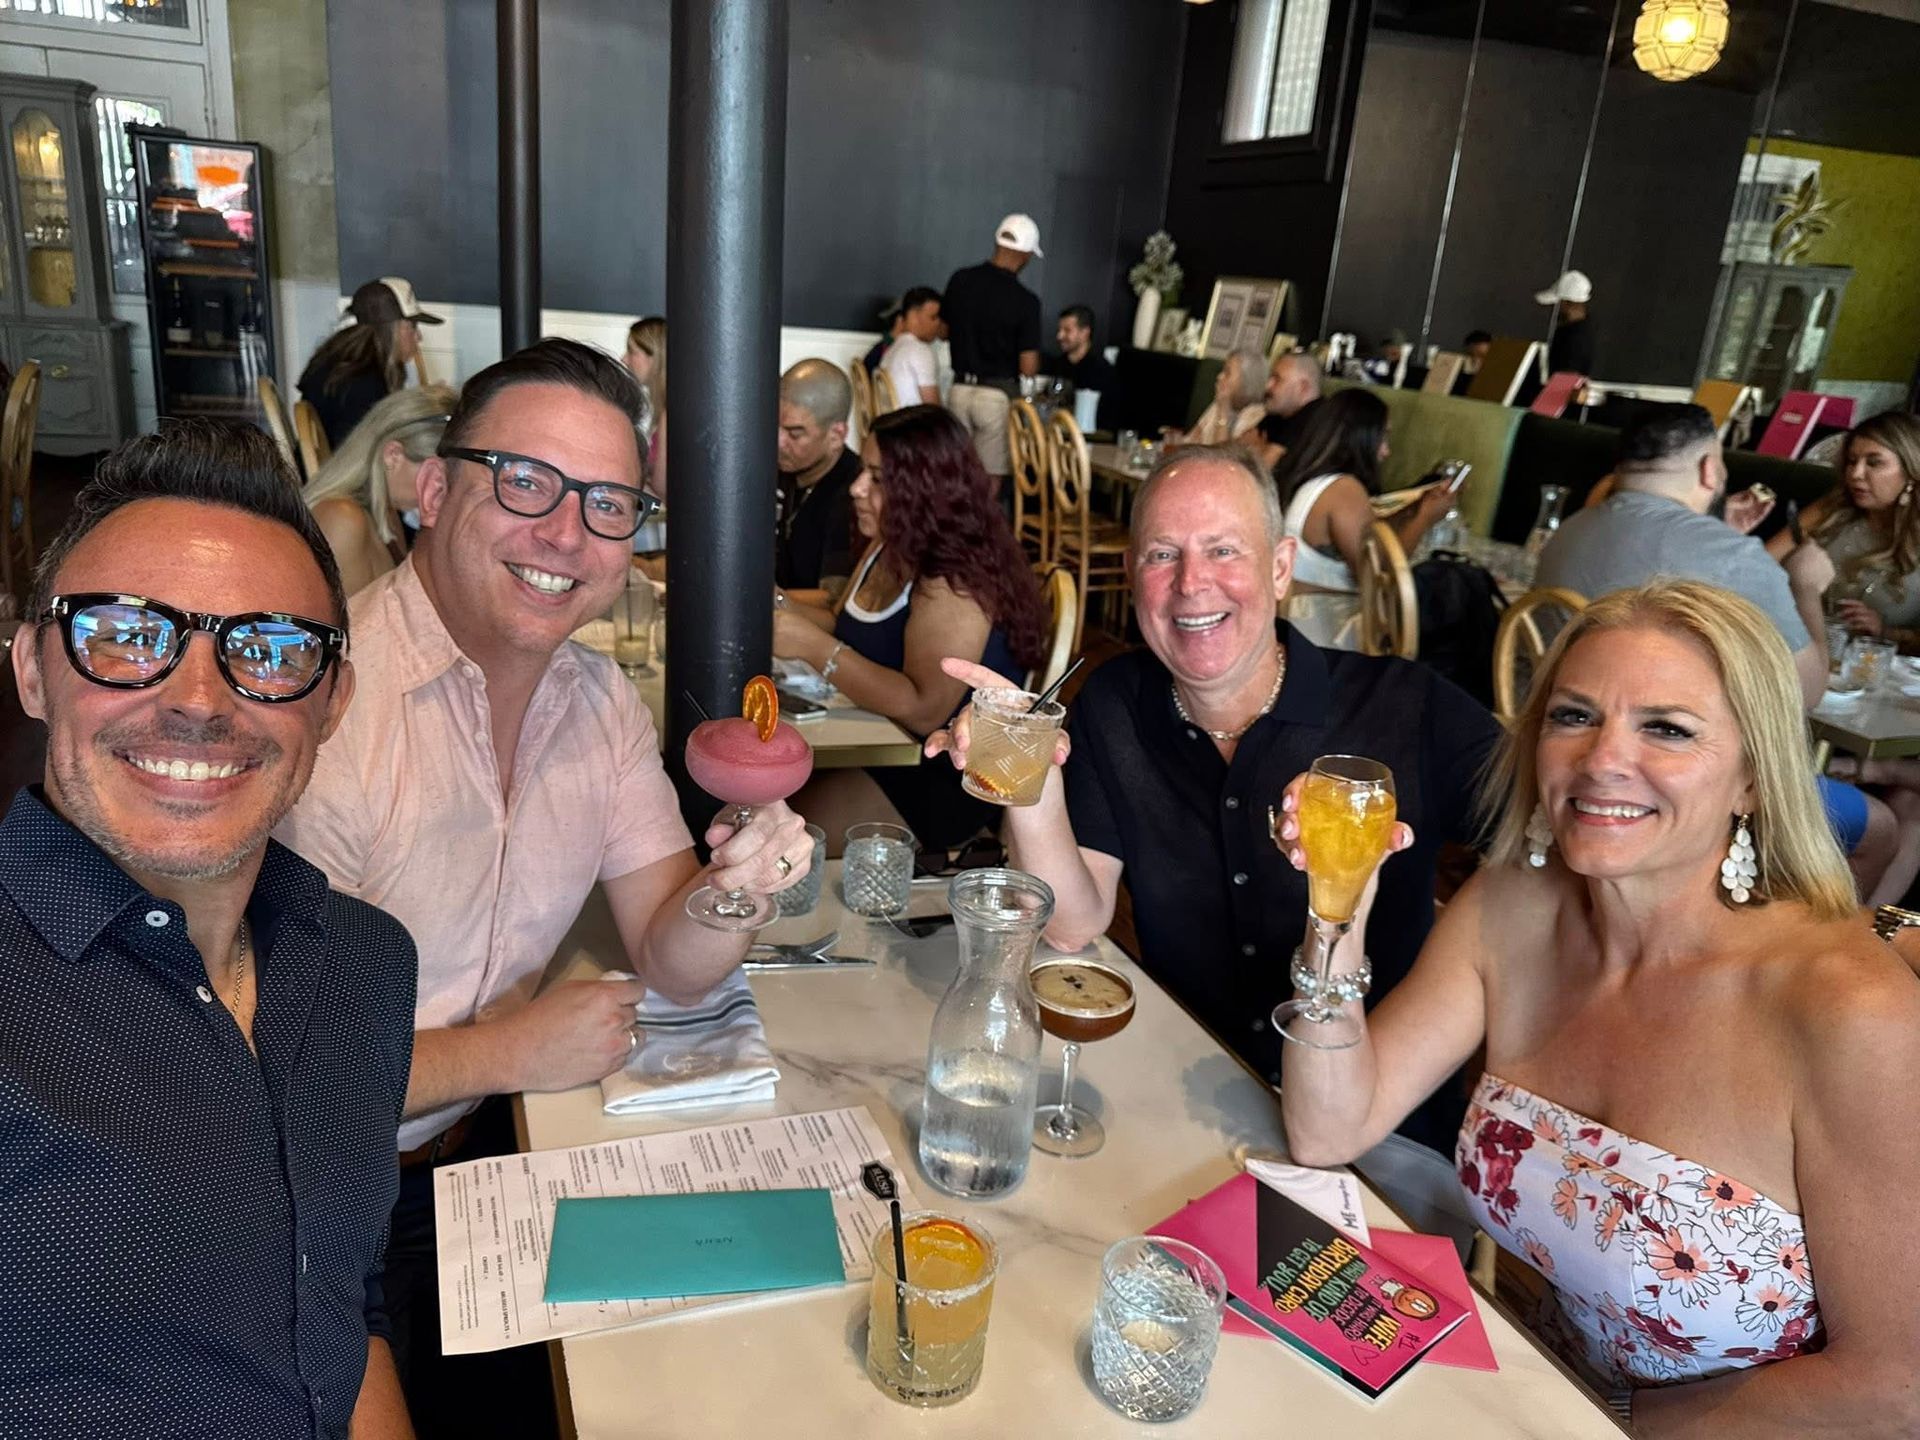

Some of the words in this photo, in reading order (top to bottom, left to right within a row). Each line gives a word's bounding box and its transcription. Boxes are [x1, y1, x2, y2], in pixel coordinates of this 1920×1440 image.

[1286, 1248, 1311, 1269] GET
[1338, 1260, 1367, 1283] WHAT
[1273, 1284, 1306, 1313] CARD
[1302, 1301, 1328, 1322] OF
[1343, 1316, 1369, 1339] HARD
[1398, 1332, 1420, 1351] #1
